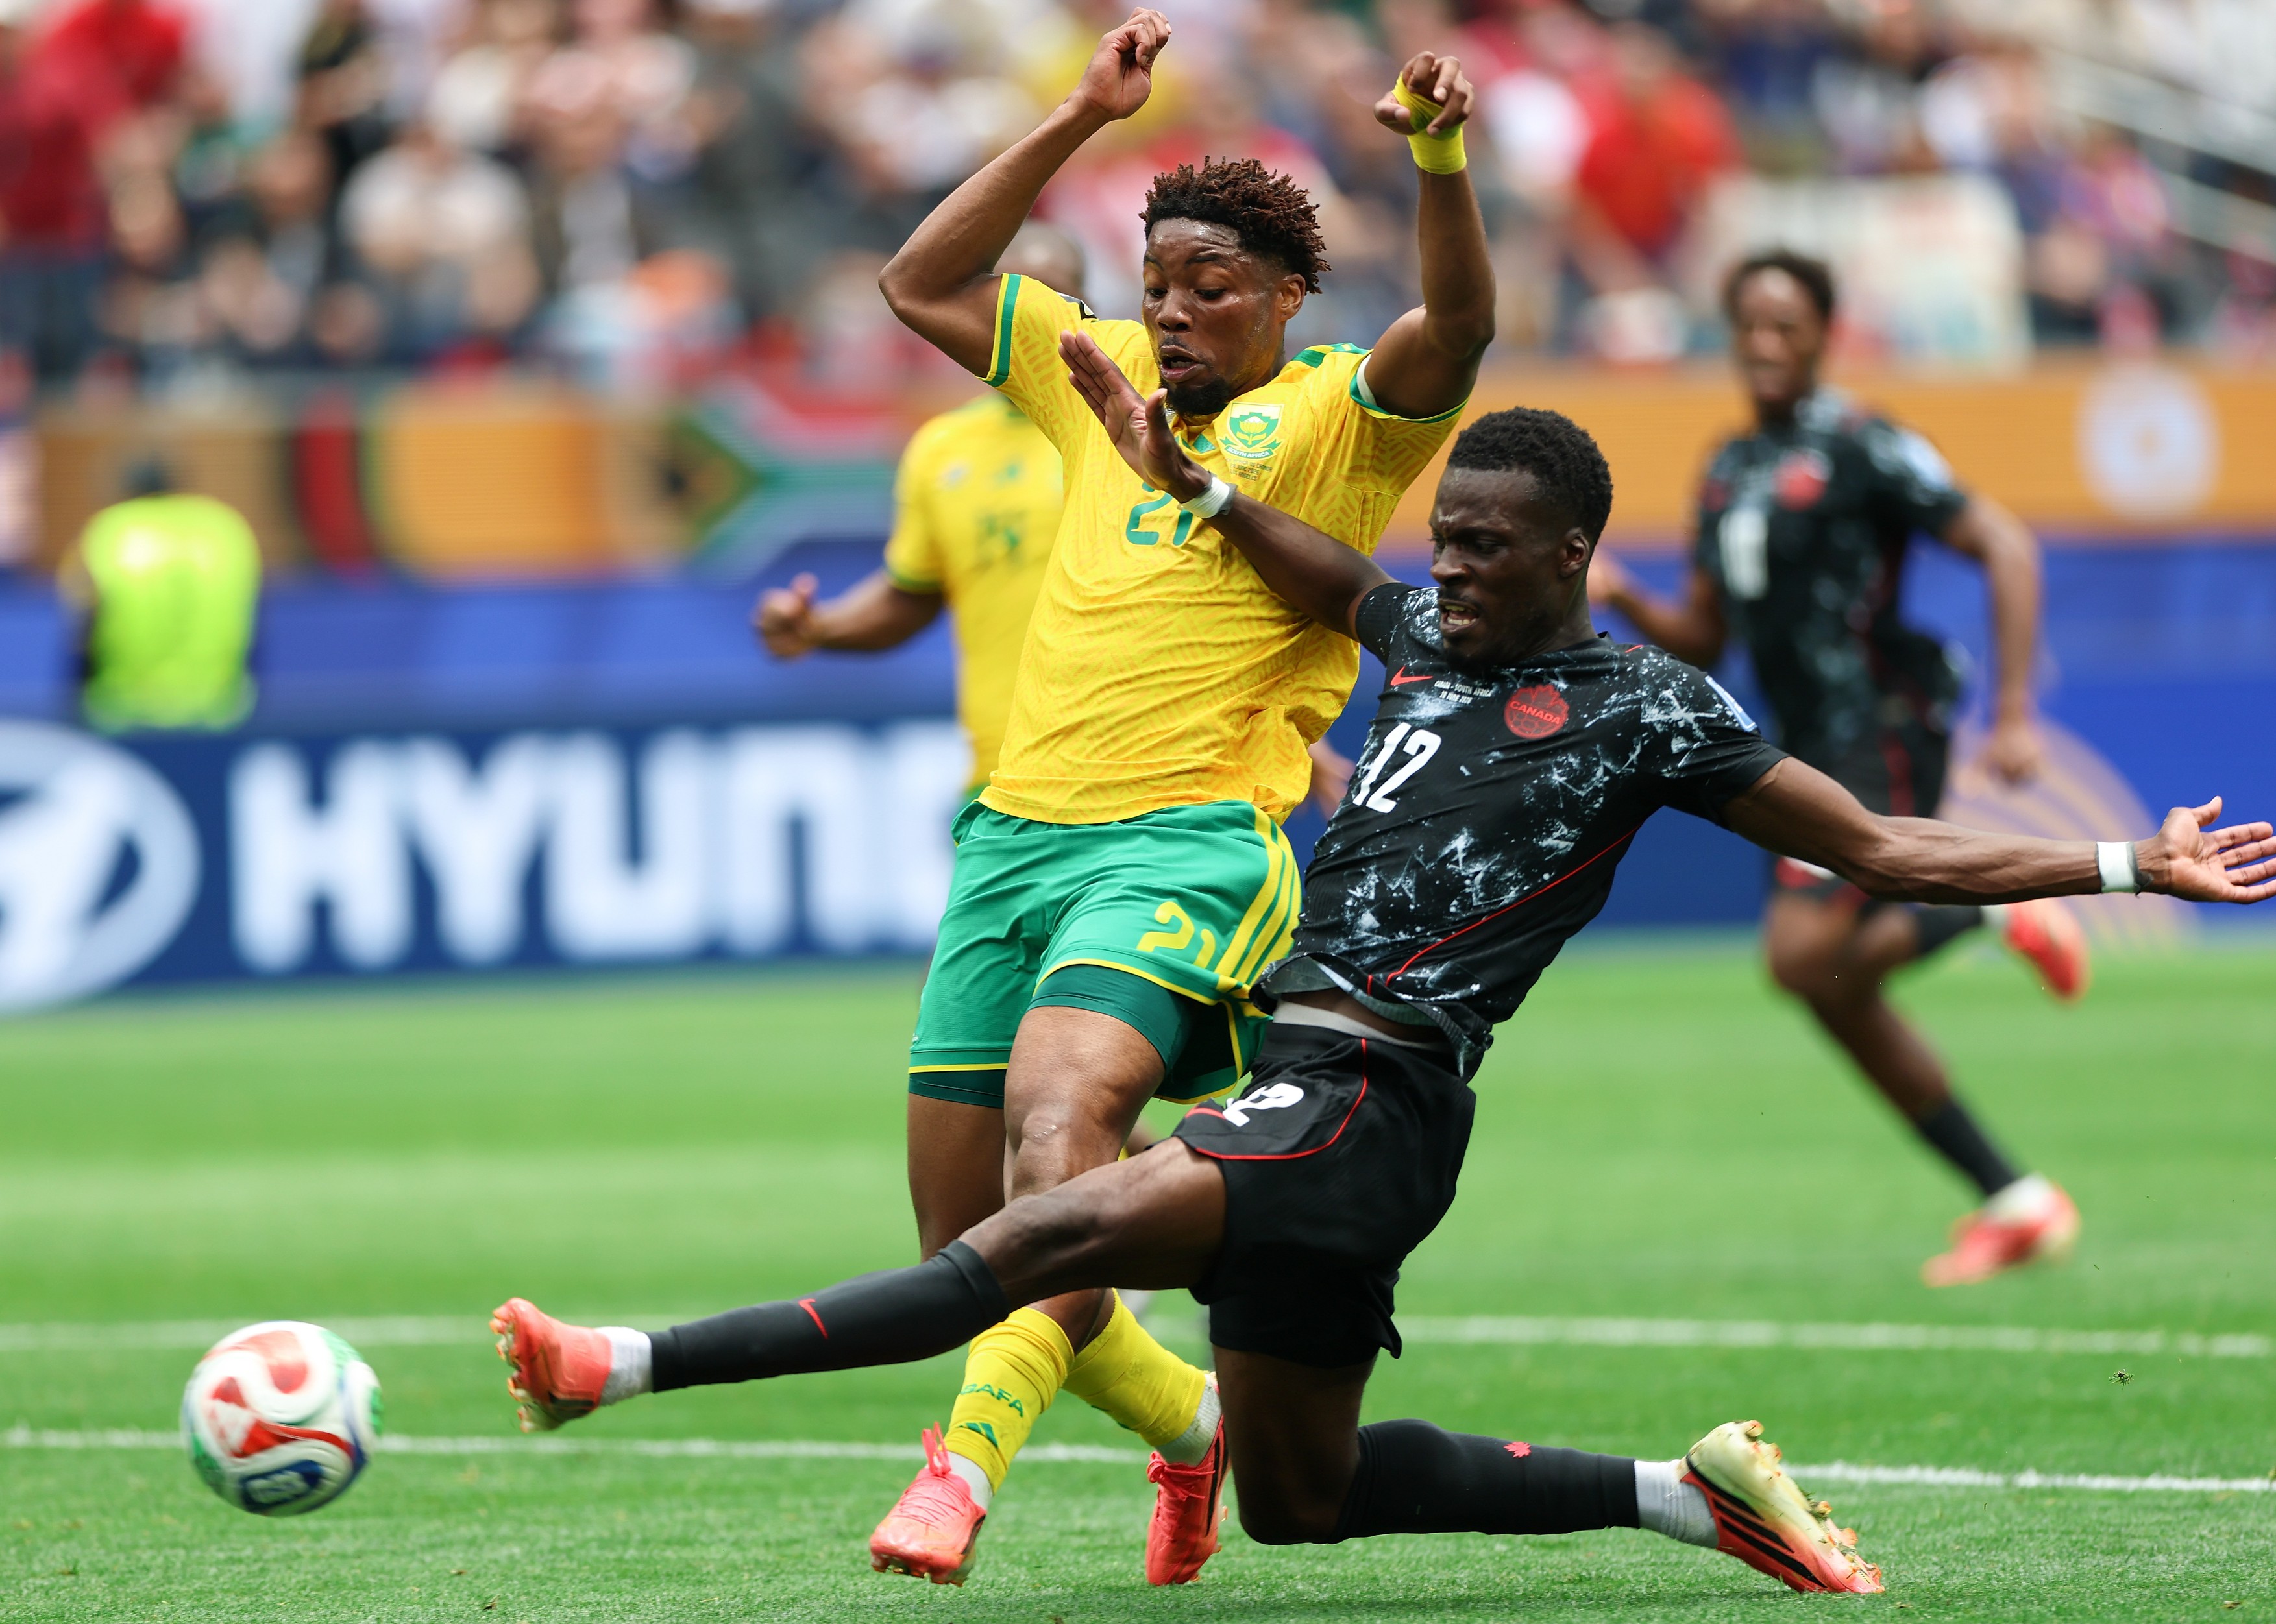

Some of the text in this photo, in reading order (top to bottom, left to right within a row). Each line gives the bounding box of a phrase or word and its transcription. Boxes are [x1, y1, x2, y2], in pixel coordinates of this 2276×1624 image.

[1227, 447, 1247, 457] SOUTH
[1126, 482, 1193, 546] 21
[1454, 683, 1473, 694] SOUTH
[1473, 688, 1493, 697] AFRICA
[1510, 700, 1561, 725] CANADA
[1352, 722, 1442, 814] 12
[1136, 901, 1216, 969] 21
[960, 1383, 1023, 1418] SAFA
